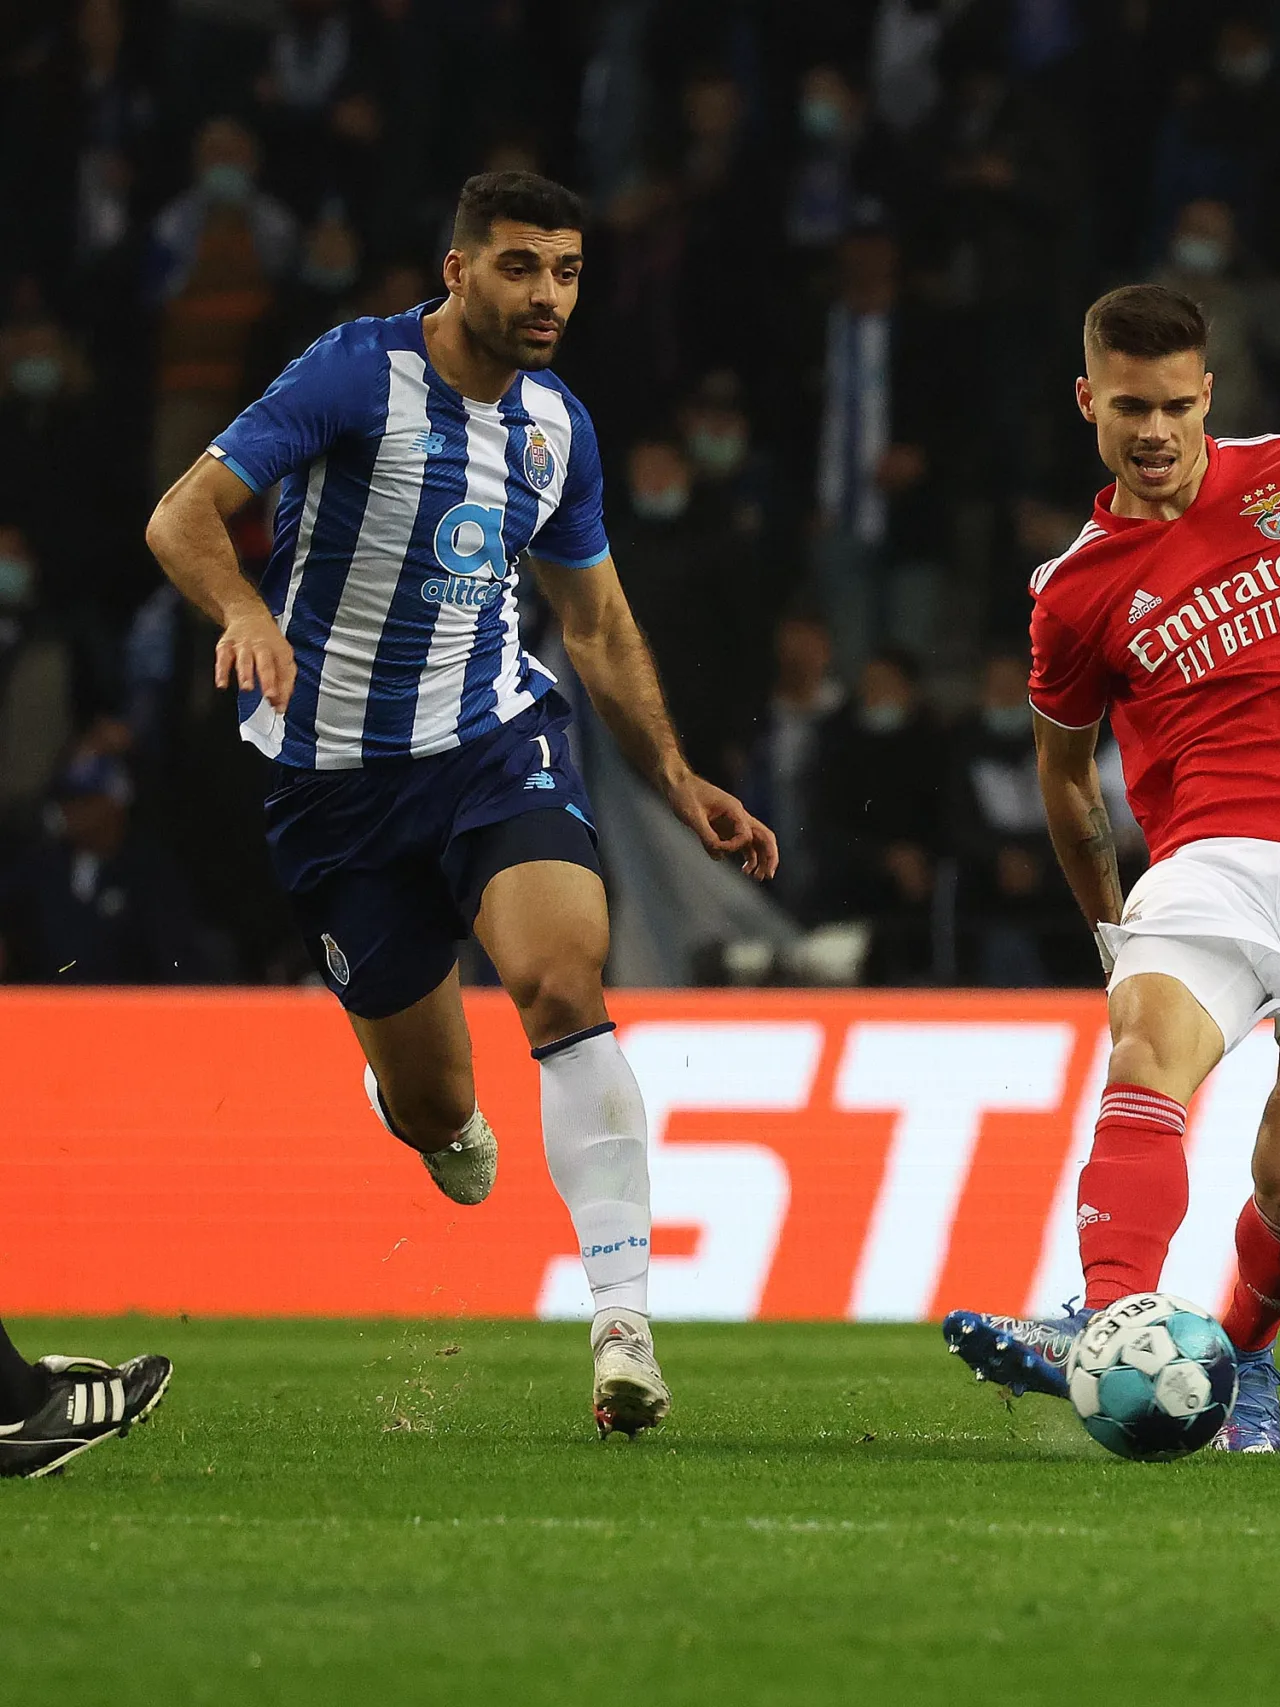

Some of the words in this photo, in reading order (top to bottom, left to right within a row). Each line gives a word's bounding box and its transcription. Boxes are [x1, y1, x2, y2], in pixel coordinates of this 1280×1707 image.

[421, 574, 502, 606] altice
[1128, 596, 1162, 624] adidas
[1175, 635, 1215, 684] FLY
[1087, 1297, 1158, 1360] SELECT
